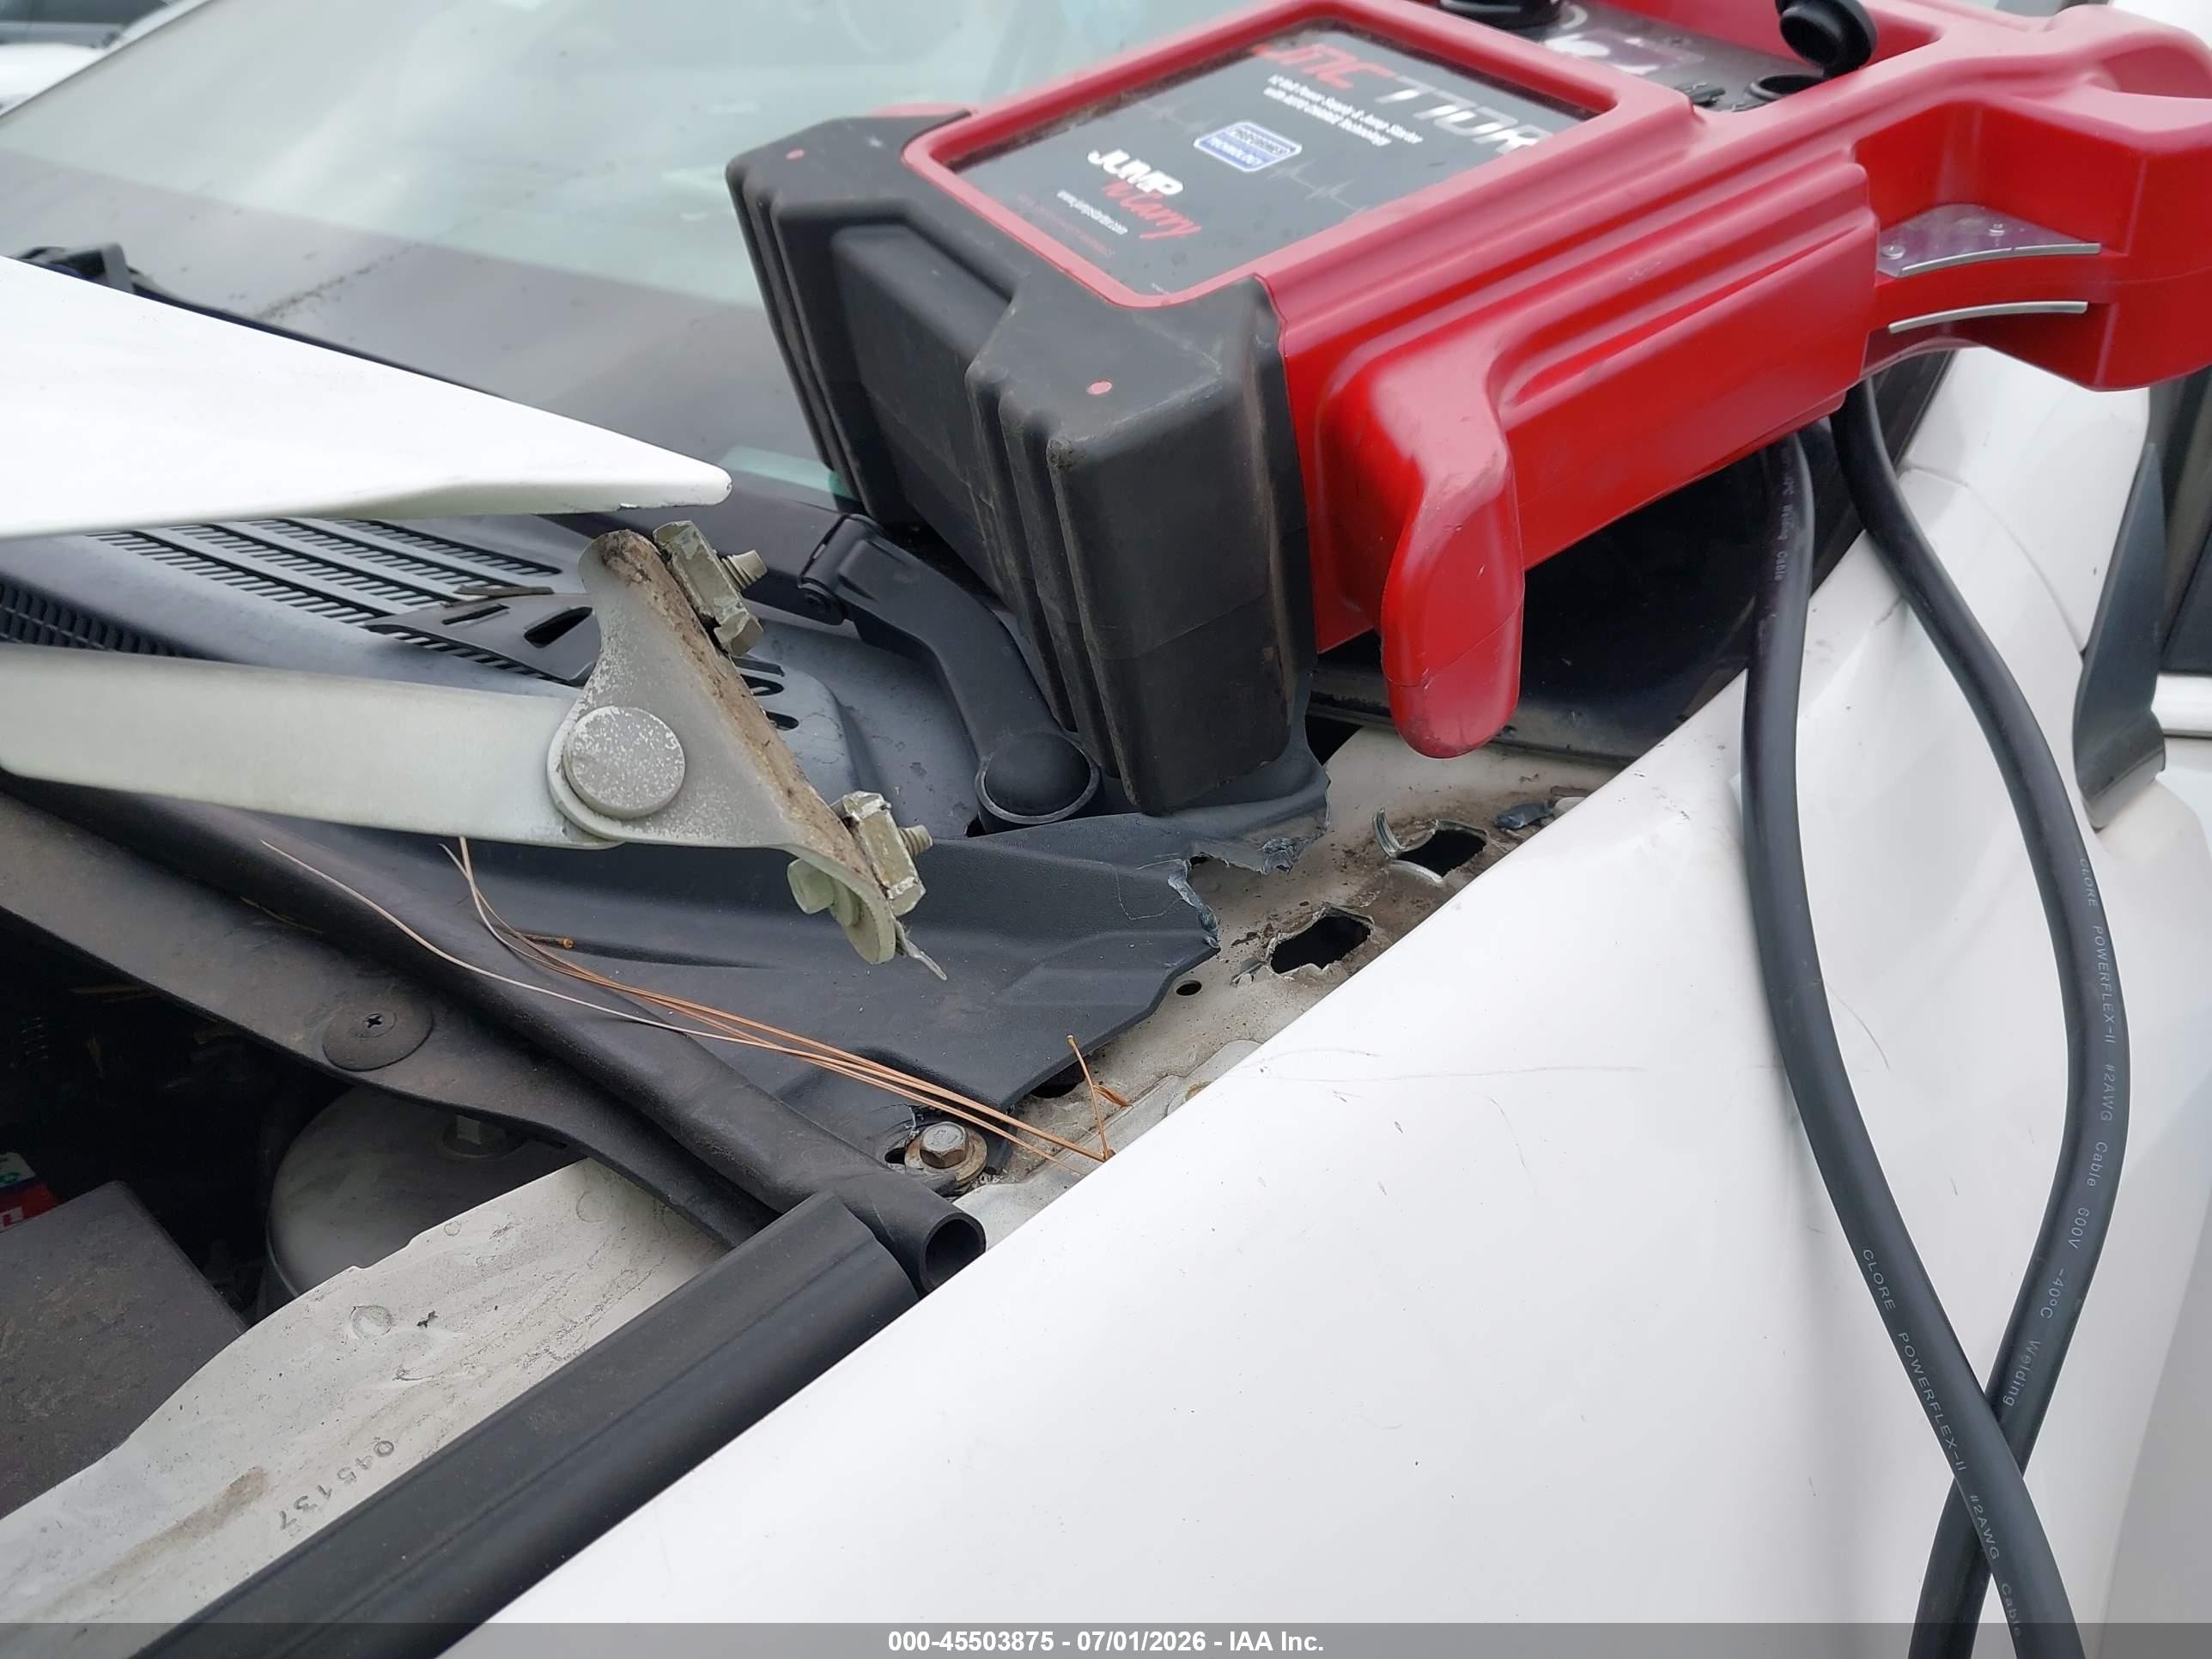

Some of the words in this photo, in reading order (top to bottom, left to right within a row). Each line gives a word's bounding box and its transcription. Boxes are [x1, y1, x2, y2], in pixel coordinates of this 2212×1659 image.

[1087, 149, 1183, 195] JUMP
[2087, 1140, 2108, 1187] Cable
[2068, 1206, 2090, 1249] 600V
[1863, 1249, 1896, 1311] CLORE
[2002, 1340, 2041, 1407] Welding
